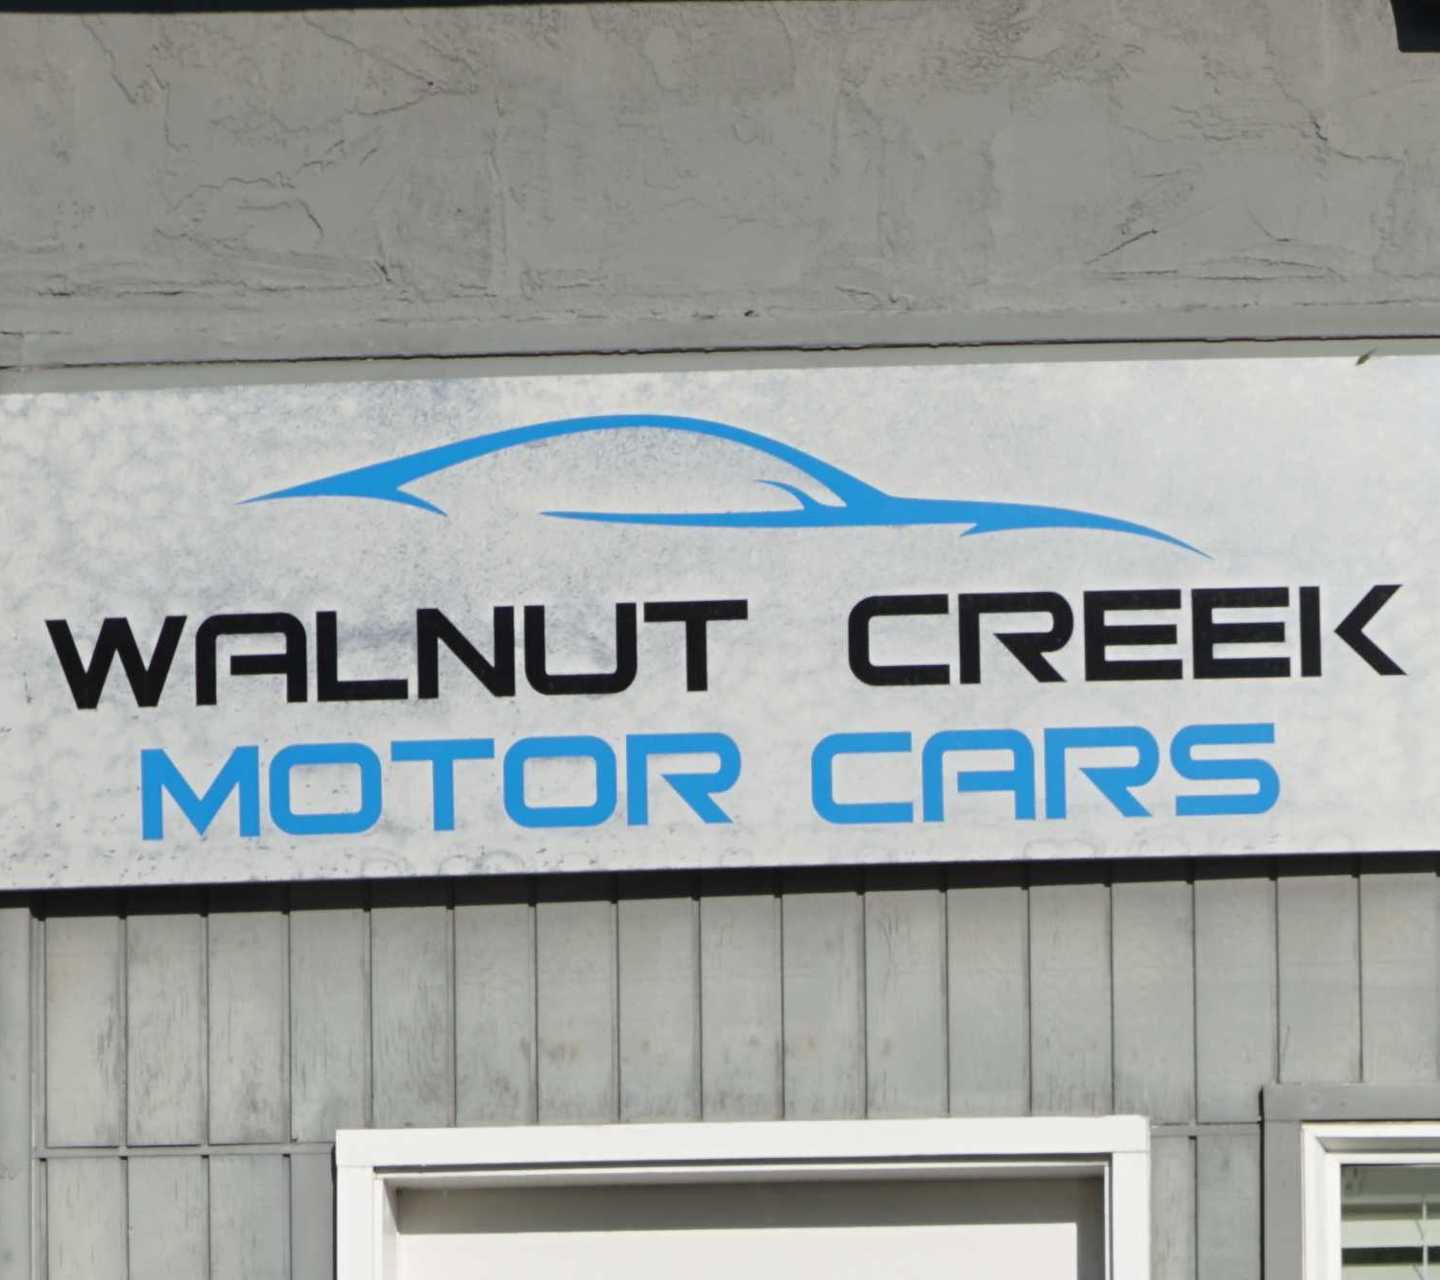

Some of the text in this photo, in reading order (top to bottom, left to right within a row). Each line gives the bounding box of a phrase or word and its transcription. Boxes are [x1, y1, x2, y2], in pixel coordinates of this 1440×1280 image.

[46, 585, 1404, 709] WALNUT CREEK
[141, 723, 1280, 840] MOTOR CARS
